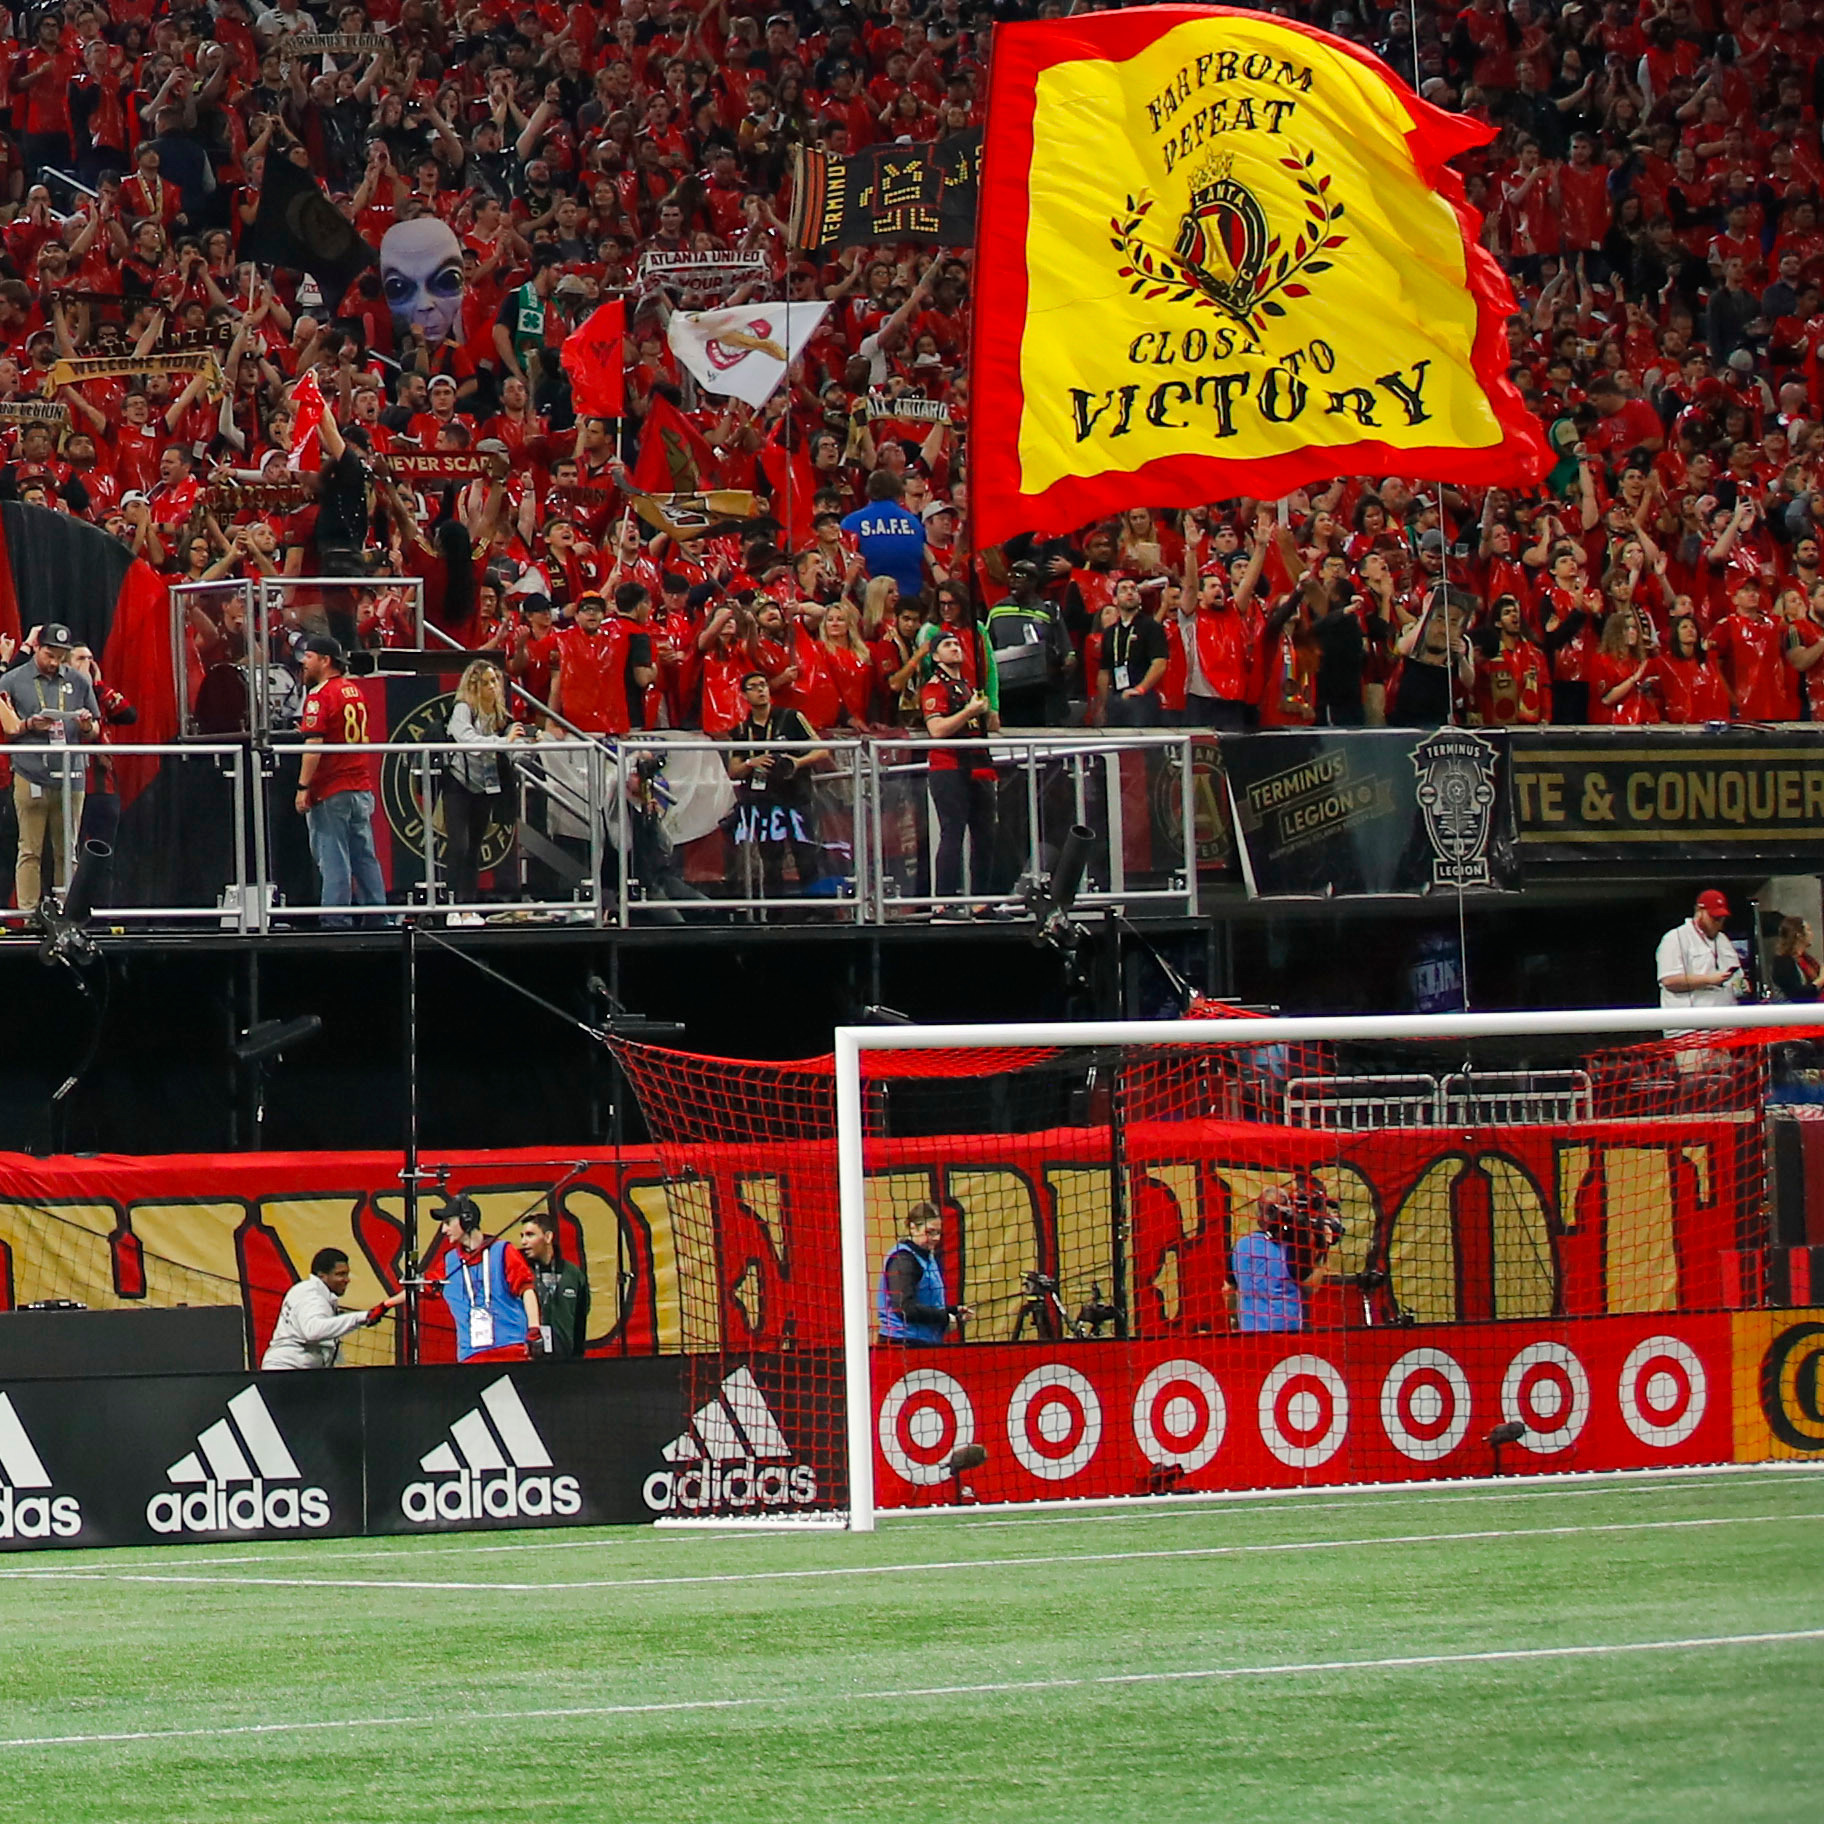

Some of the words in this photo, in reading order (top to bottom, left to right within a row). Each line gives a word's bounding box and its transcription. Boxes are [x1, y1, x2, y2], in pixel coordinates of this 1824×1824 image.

[1194, 49, 1315, 95] FROM
[1162, 97, 1297, 174] DEFEAT
[821, 150, 848, 246] TERMINUS
[650, 250, 708, 267] ATLANTA
[711, 249, 762, 264] UNITED
[73, 358, 154, 376] WELCOME
[160, 354, 211, 372] HOME
[1280, 338, 1336, 379] TO
[1068, 359, 1432, 443] VICTORY
[860, 518, 916, 538] S.A.F.E.
[1424, 738, 1482, 759] TERMINUS
[1249, 754, 1346, 807] TERMINUS
[1581, 771, 1616, 822] &
[1626, 770, 1824, 824] CONQUER
[1282, 785, 1356, 835] LEGION
[1438, 863, 1484, 877] LEGION
[146, 1477, 331, 1534] adidas
[400, 1466, 583, 1524] adidas
[642, 1457, 815, 1515] adidas
